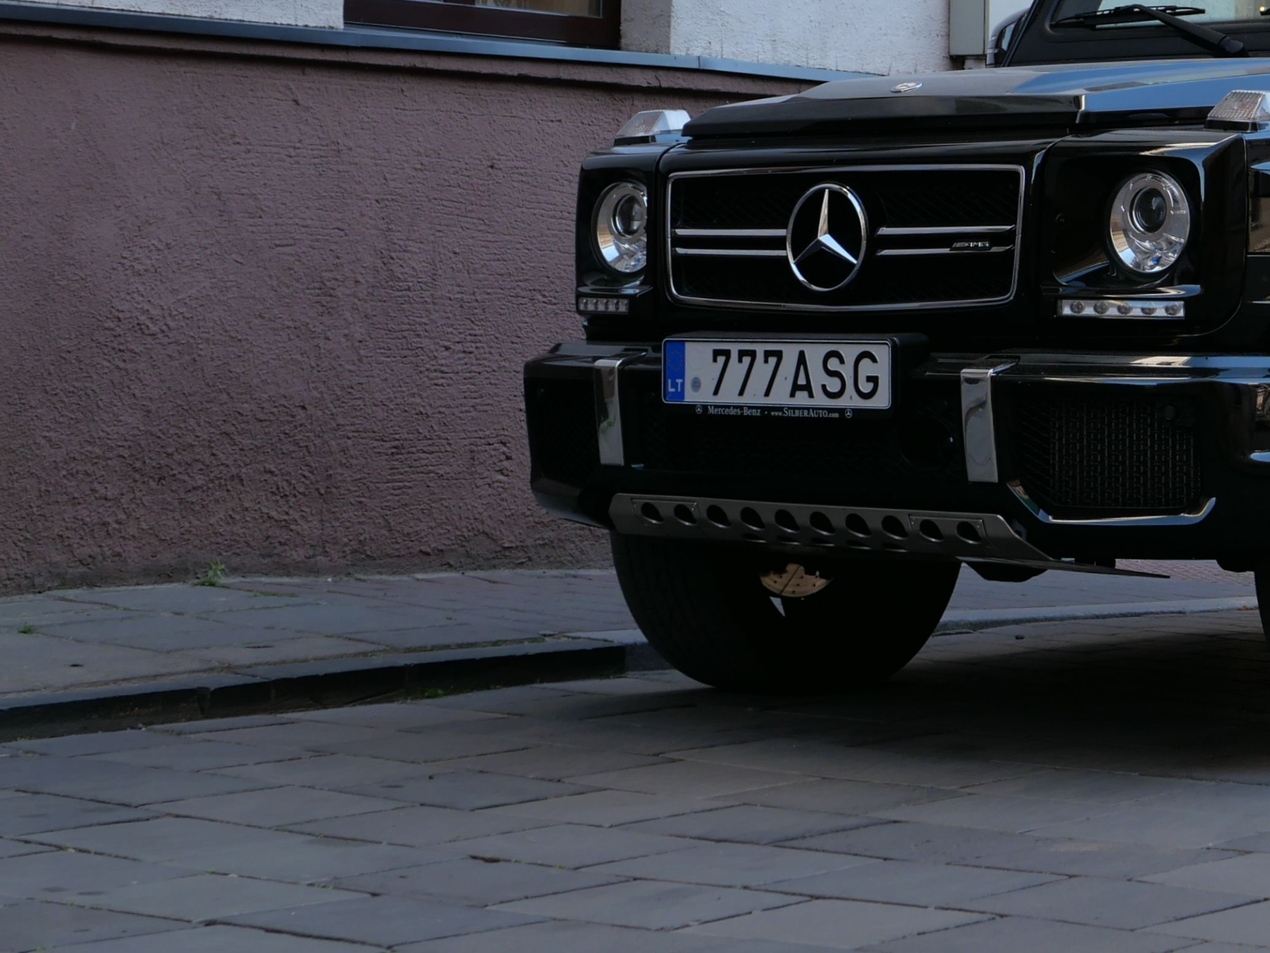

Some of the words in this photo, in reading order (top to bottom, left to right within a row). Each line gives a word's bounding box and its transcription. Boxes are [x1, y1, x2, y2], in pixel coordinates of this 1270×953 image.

[712, 348, 881, 401] 777ASG
[667, 378, 684, 393] LT
[707, 405, 762, 417] Mercedes-Benz
